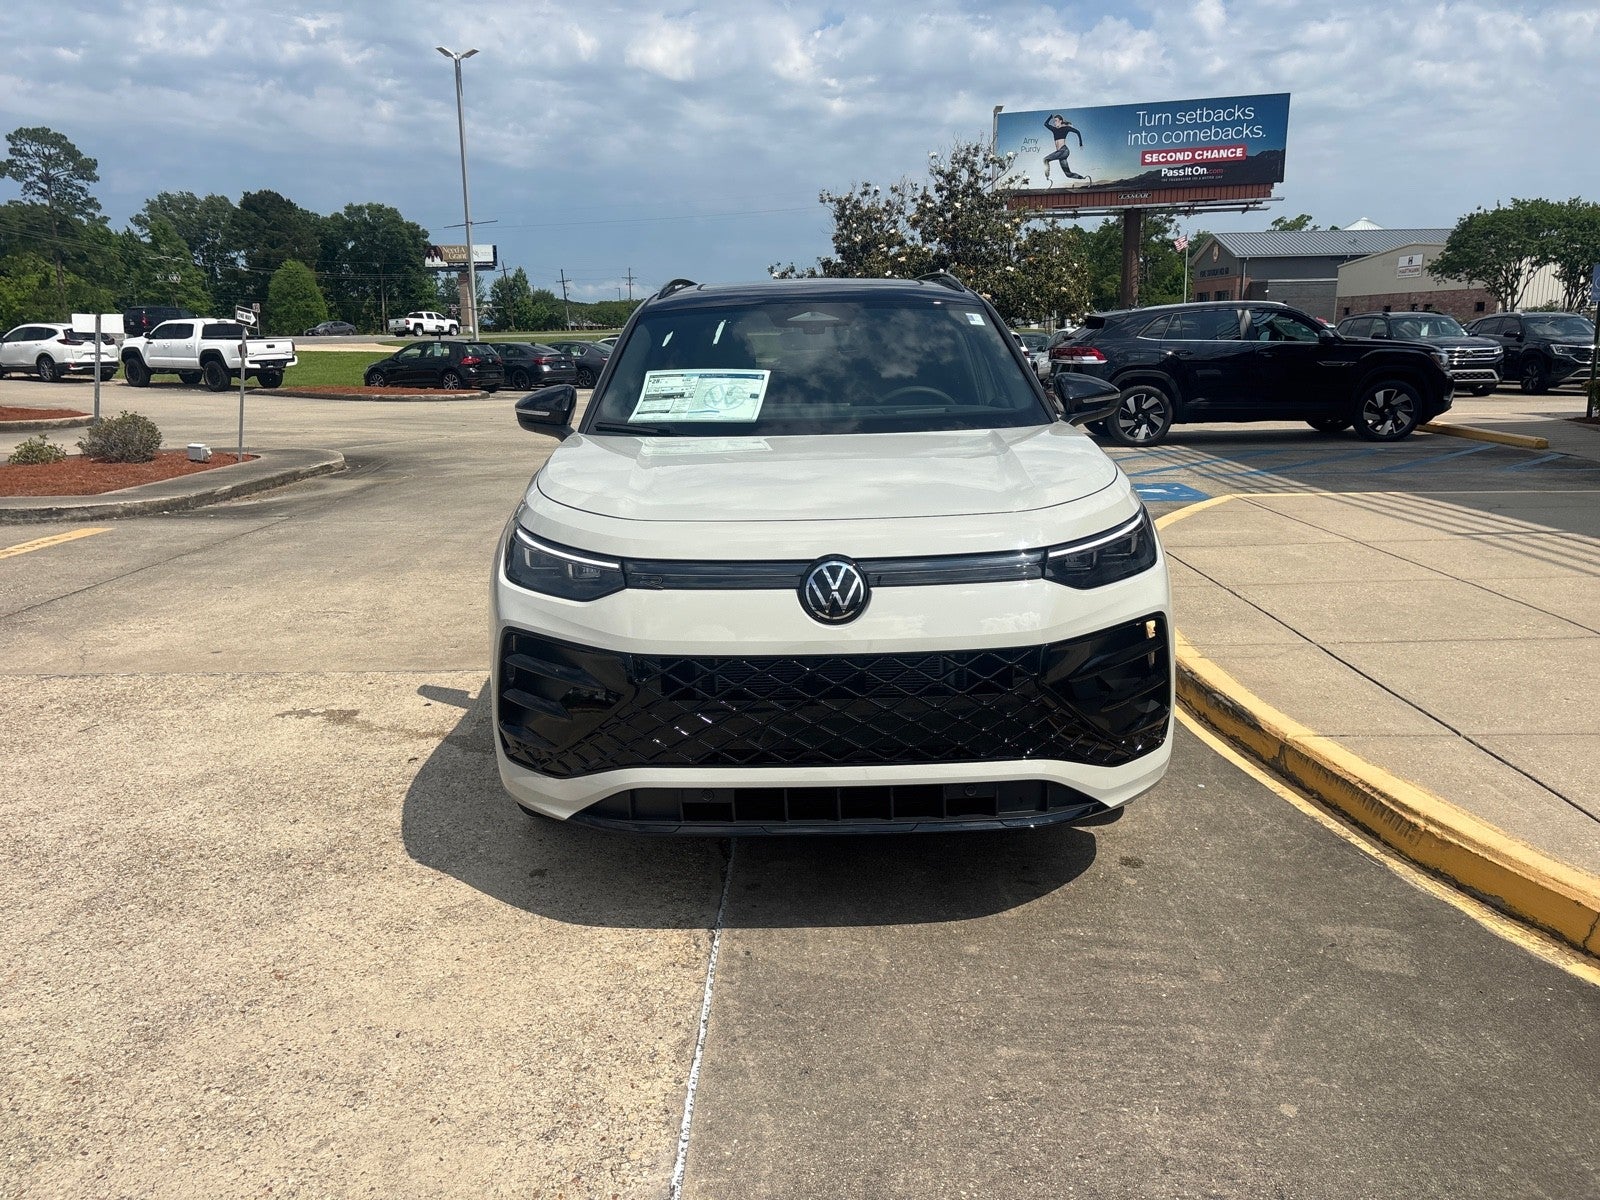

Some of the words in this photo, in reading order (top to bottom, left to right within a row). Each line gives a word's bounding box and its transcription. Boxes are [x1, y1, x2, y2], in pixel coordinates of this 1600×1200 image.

[1136, 110, 1172, 127] Turn
[1175, 104, 1255, 125] setbacks
[1022, 137, 1039, 145] Amy
[1128, 130, 1158, 146] into
[1162, 123, 1266, 144] comebacks.
[1020, 145, 1041, 154] Purdy
[1144, 151, 1193, 163] SECOND
[1194, 147, 1243, 160] CHANCE
